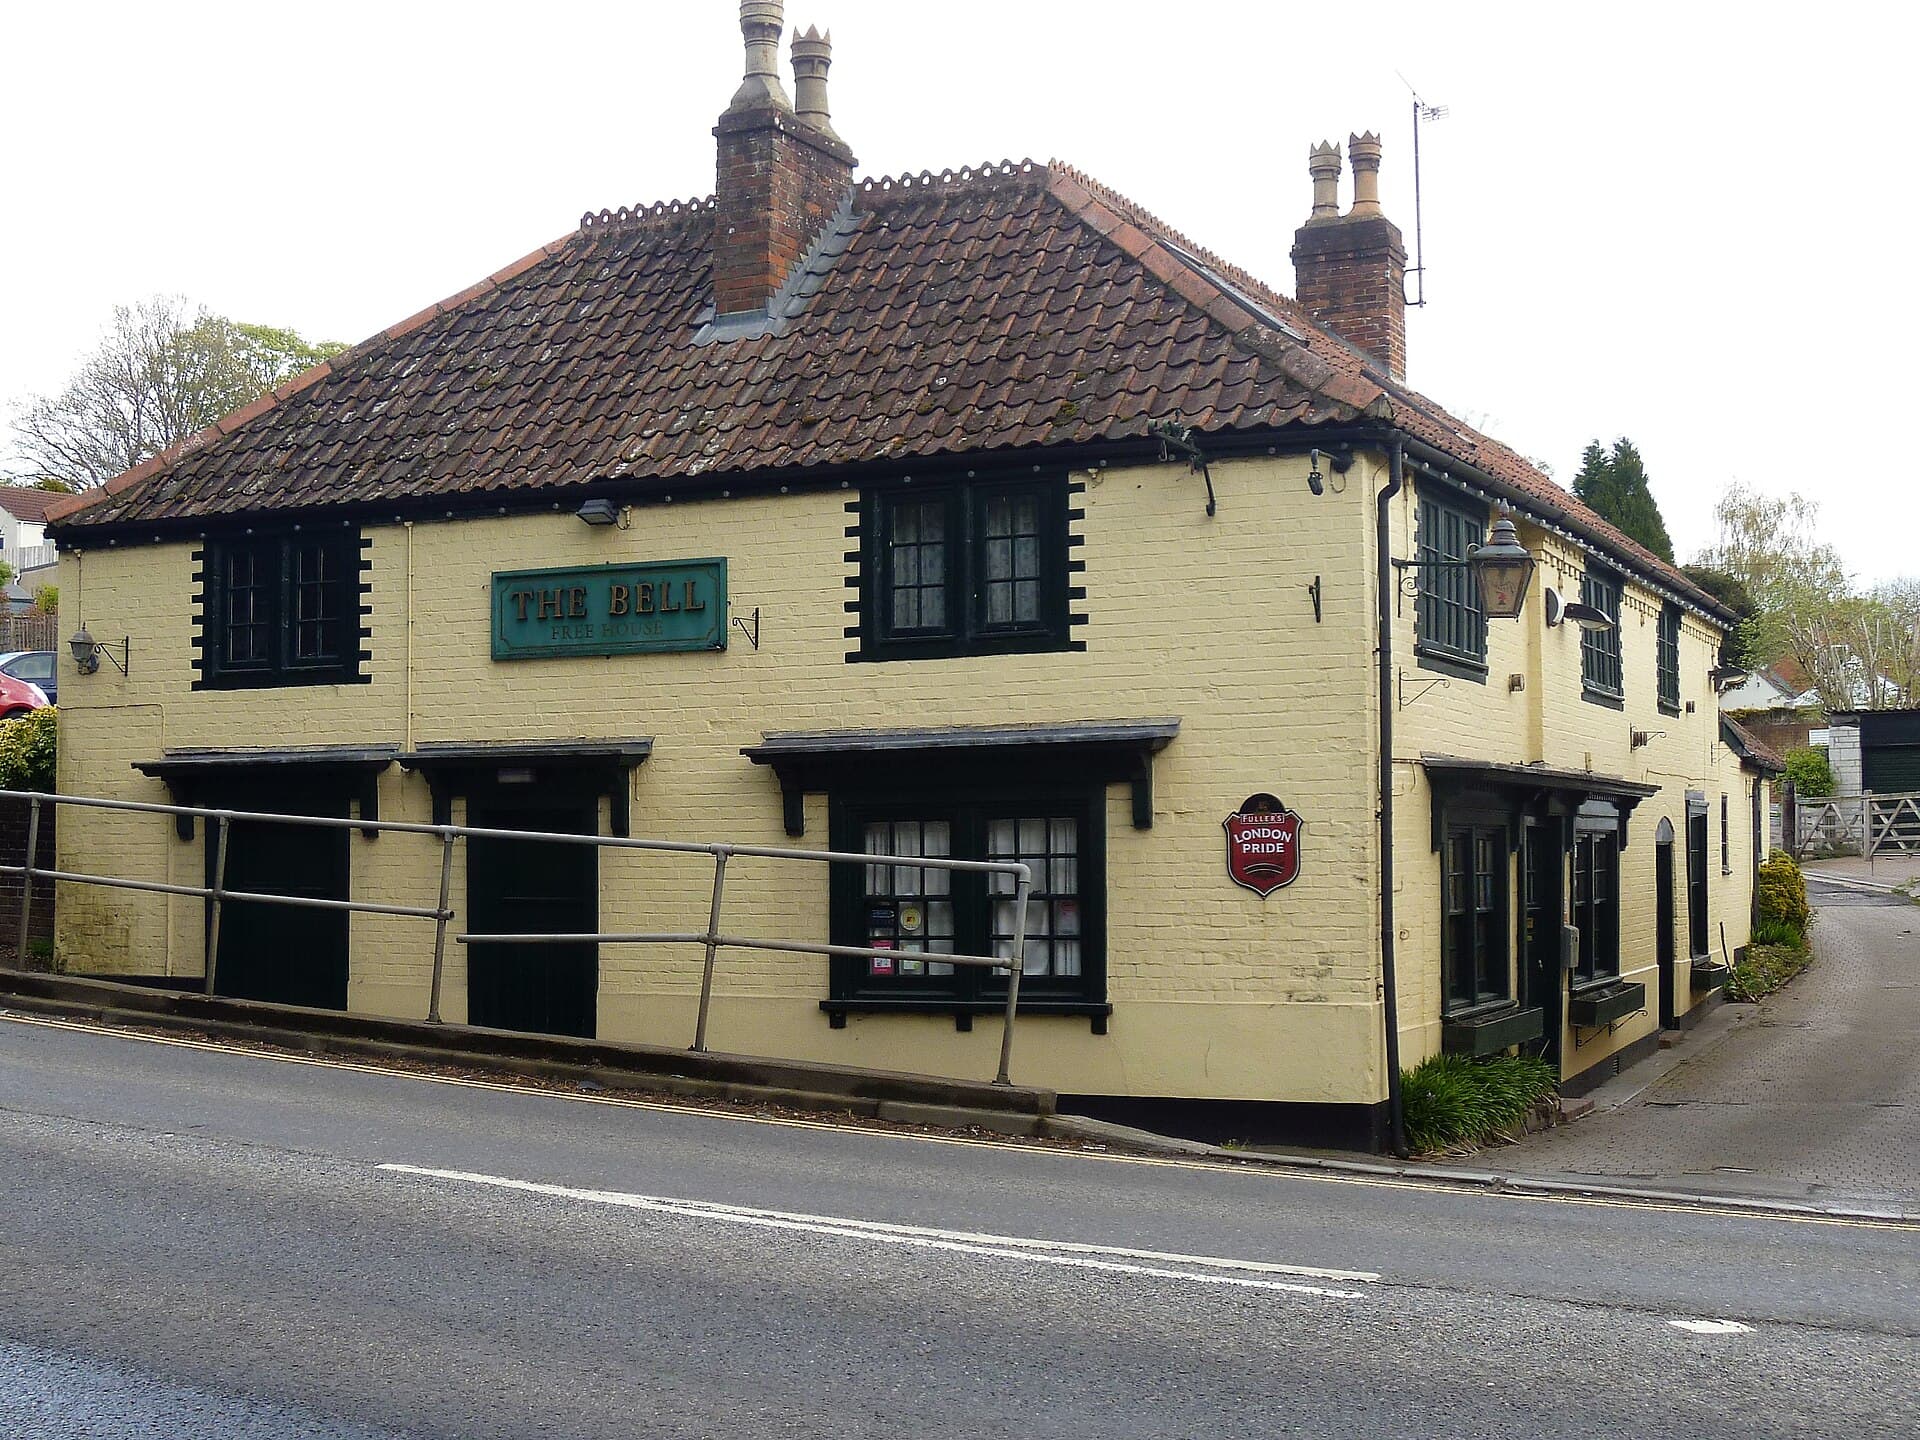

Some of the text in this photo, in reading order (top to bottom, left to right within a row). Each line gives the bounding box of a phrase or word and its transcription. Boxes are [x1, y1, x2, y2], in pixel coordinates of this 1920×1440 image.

[512, 580, 705, 619] THE BELL
[551, 621, 664, 640] FREE HOUSE
[1243, 814, 1282, 822] FULLER'S
[1234, 828, 1292, 843] LONDON
[1243, 843, 1285, 853] PRIDE
